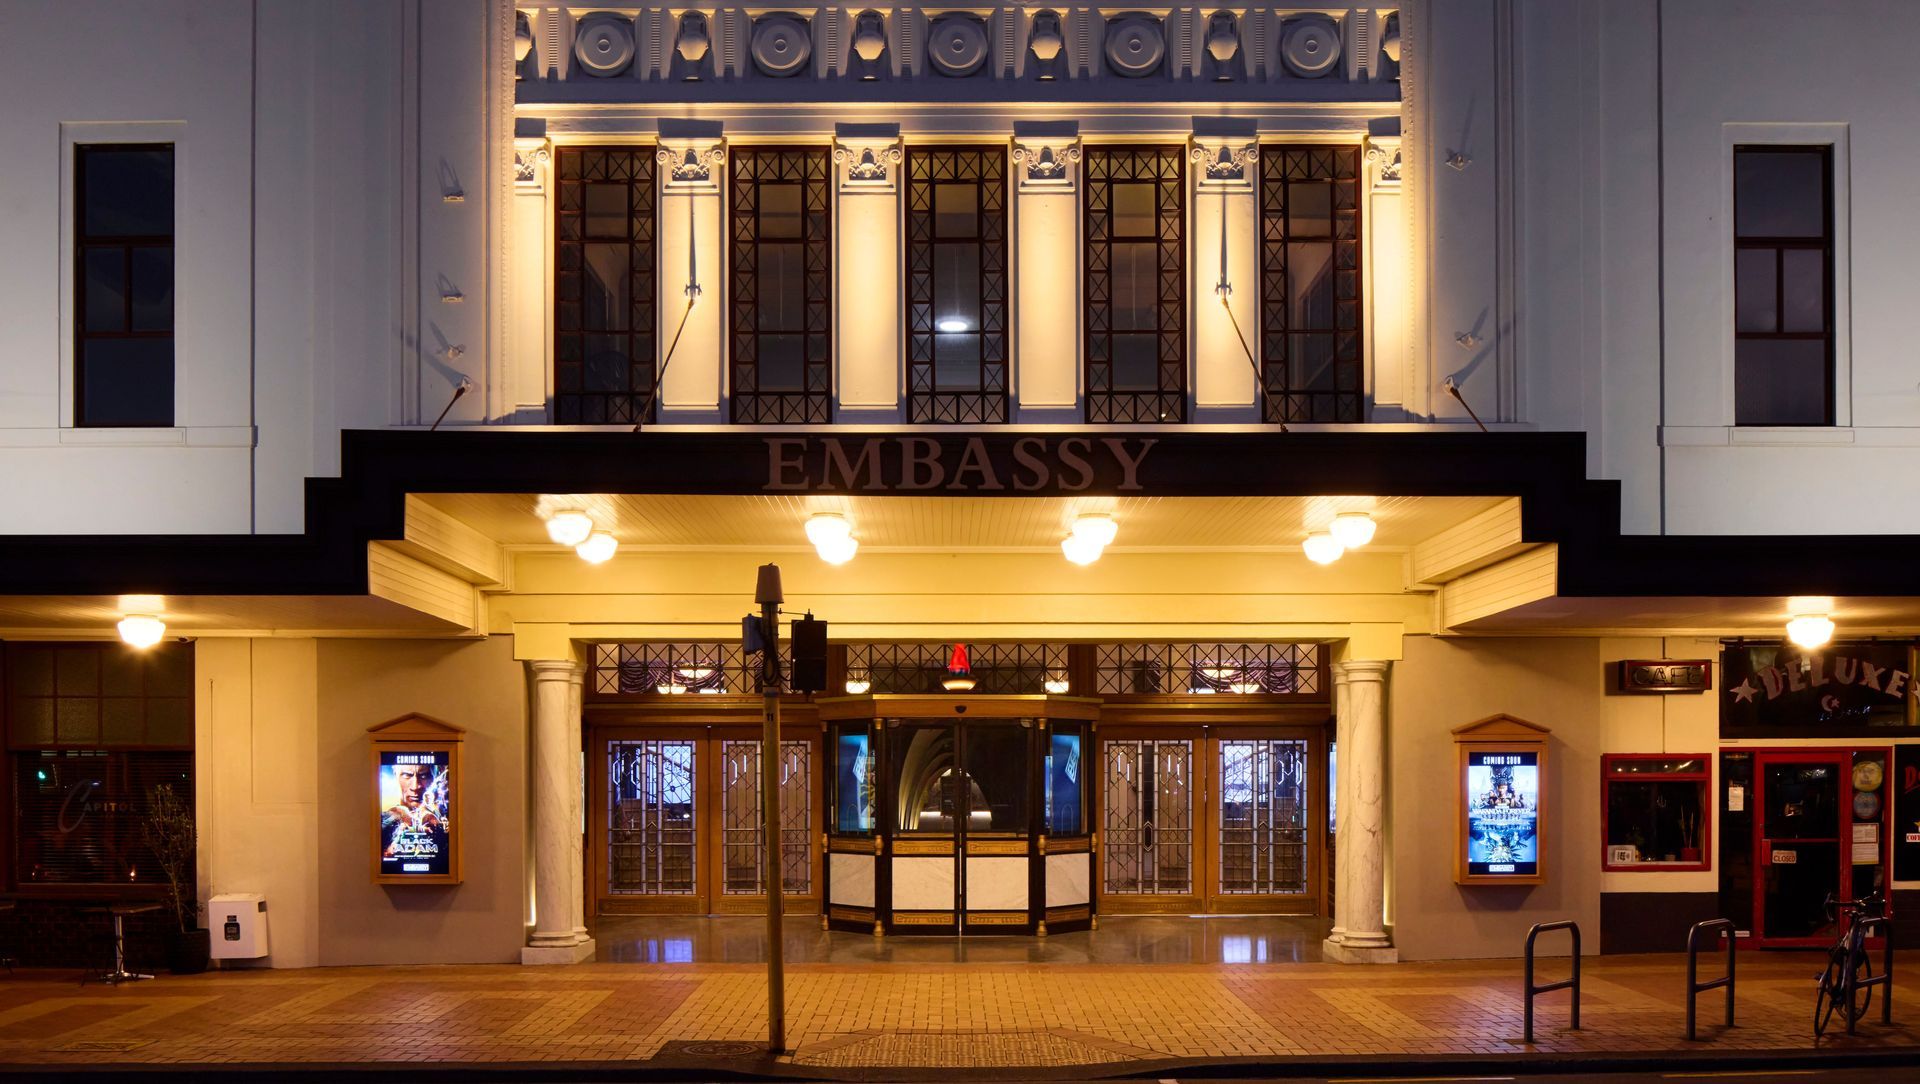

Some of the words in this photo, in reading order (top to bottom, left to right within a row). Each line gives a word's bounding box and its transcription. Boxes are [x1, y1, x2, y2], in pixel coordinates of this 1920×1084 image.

[762, 437, 1159, 491] EMBASSY
[1757, 655, 1910, 700] DELUXE
[397, 755, 418, 764] COMING
[420, 755, 435, 764] SOON
[1483, 756, 1505, 765] COMING
[1506, 756, 1521, 765] SOON
[394, 843, 439, 853] ADAM
[1773, 855, 1796, 863] CLOSED
